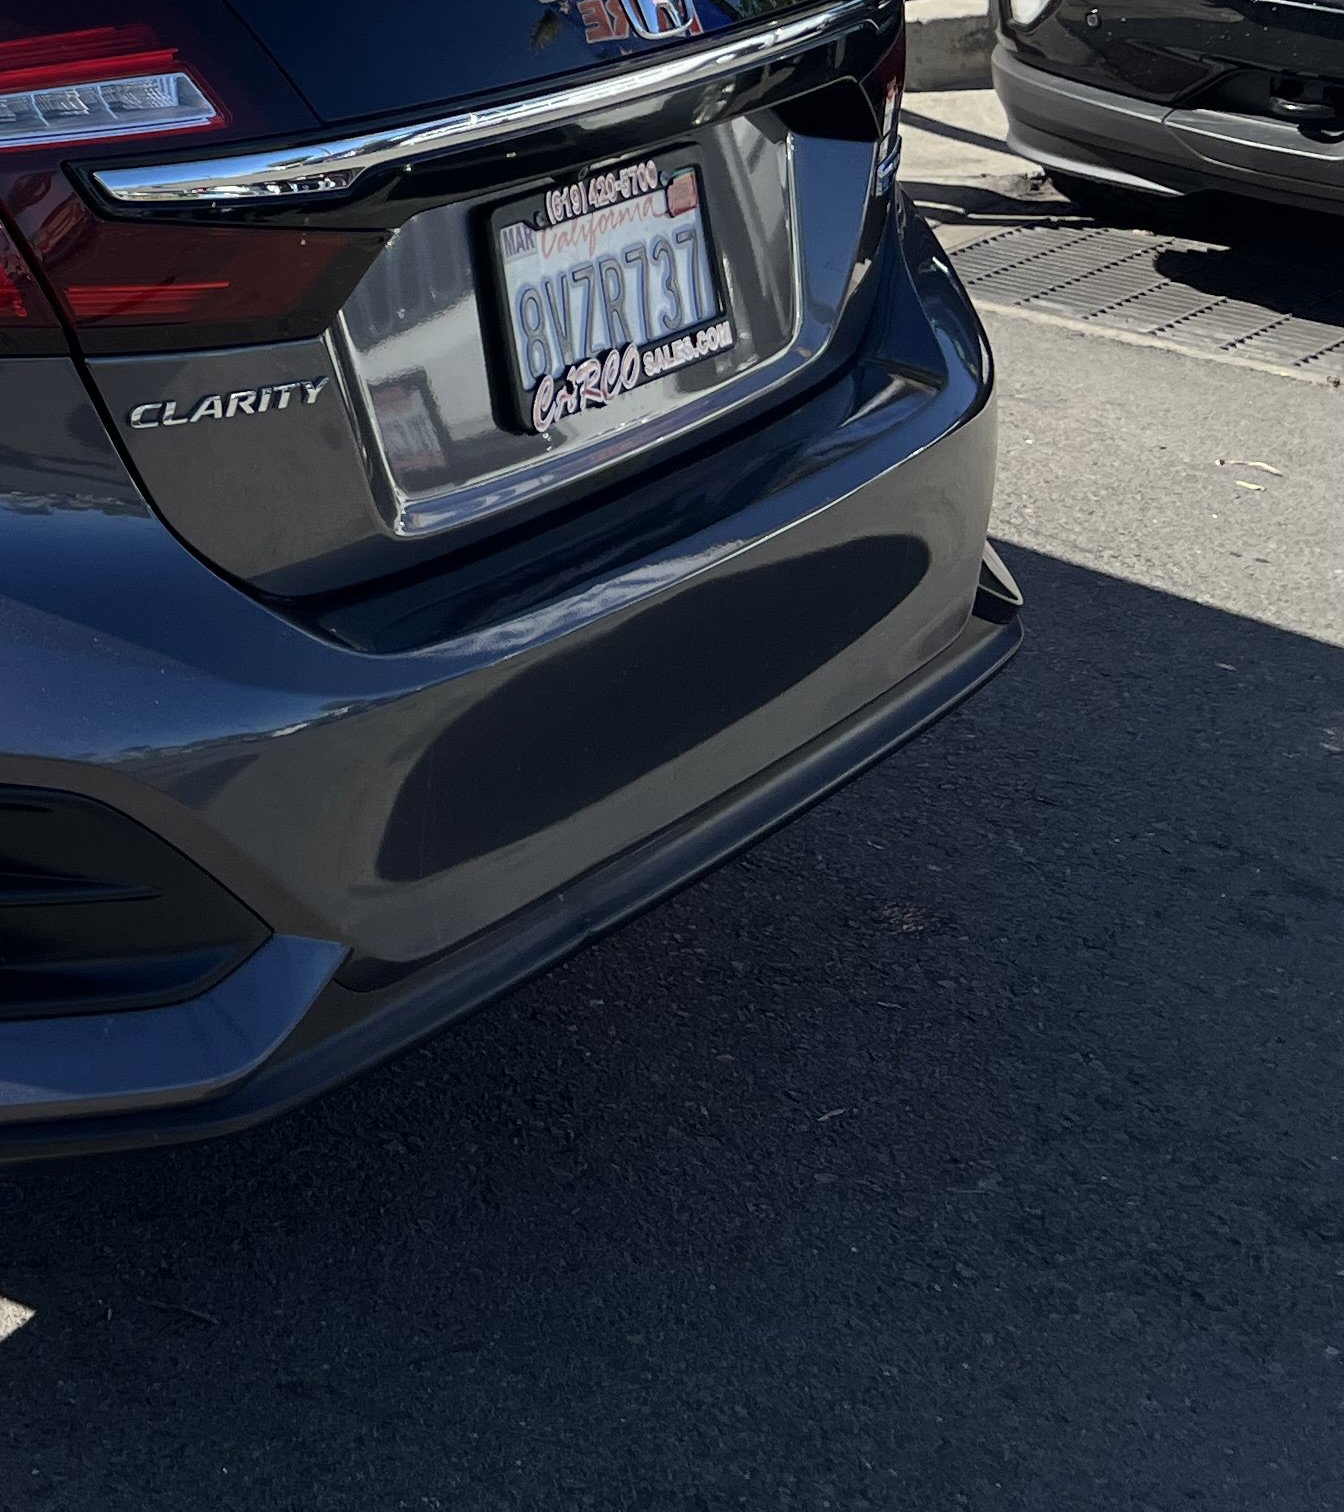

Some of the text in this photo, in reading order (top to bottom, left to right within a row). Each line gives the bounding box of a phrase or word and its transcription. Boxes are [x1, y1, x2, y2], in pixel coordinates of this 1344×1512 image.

[545, 160, 659, 225] (619) 420-5700
[503, 225, 535, 257] MAR
[540, 194, 666, 259] California
[519, 226, 703, 379] 8VZR737
[643, 321, 734, 377] SALES.COM
[129, 376, 330, 429] CLARITY
